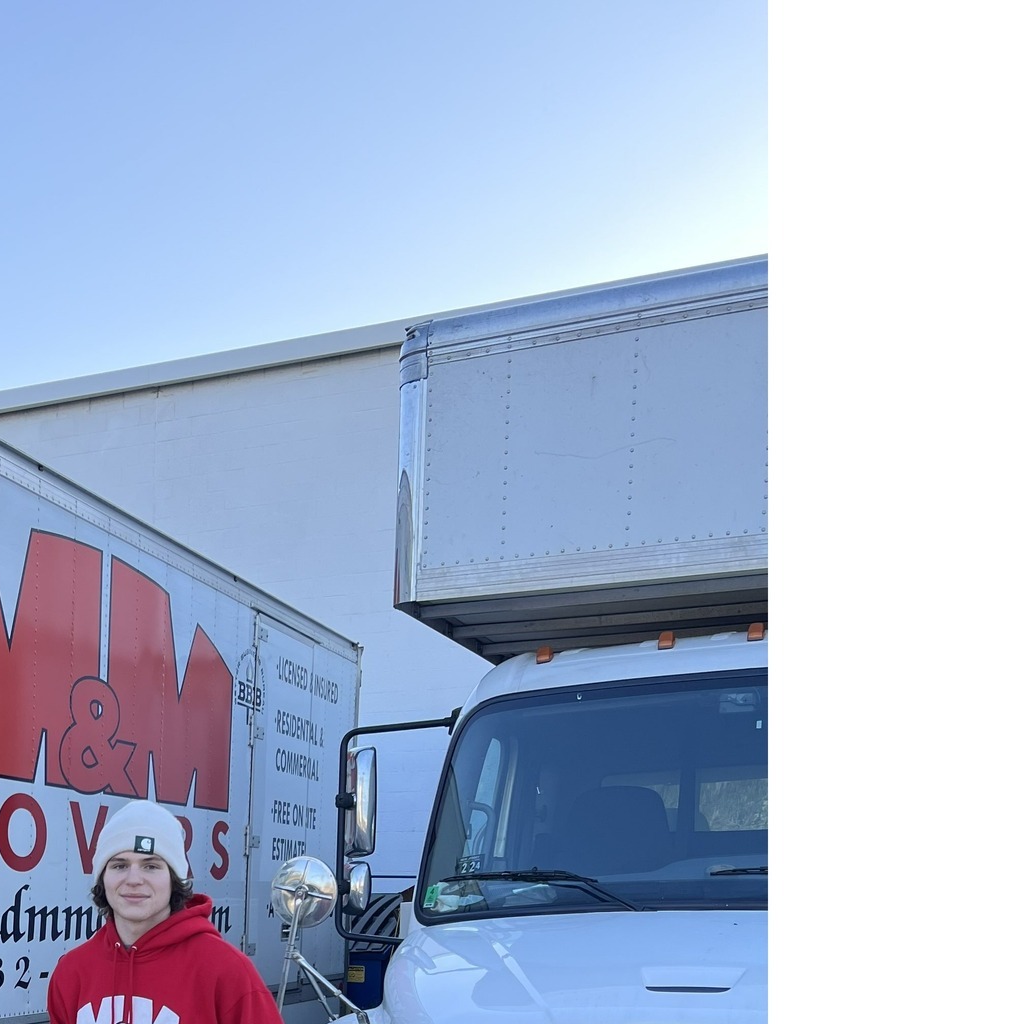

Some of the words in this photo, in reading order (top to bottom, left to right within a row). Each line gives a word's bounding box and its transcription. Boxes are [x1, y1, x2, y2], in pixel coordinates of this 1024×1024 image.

[278, 656, 307, 690] LICENSED
[238, 681, 261, 707] BBB
[273, 800, 290, 825] FREE
[293, 804, 304, 827] ON
